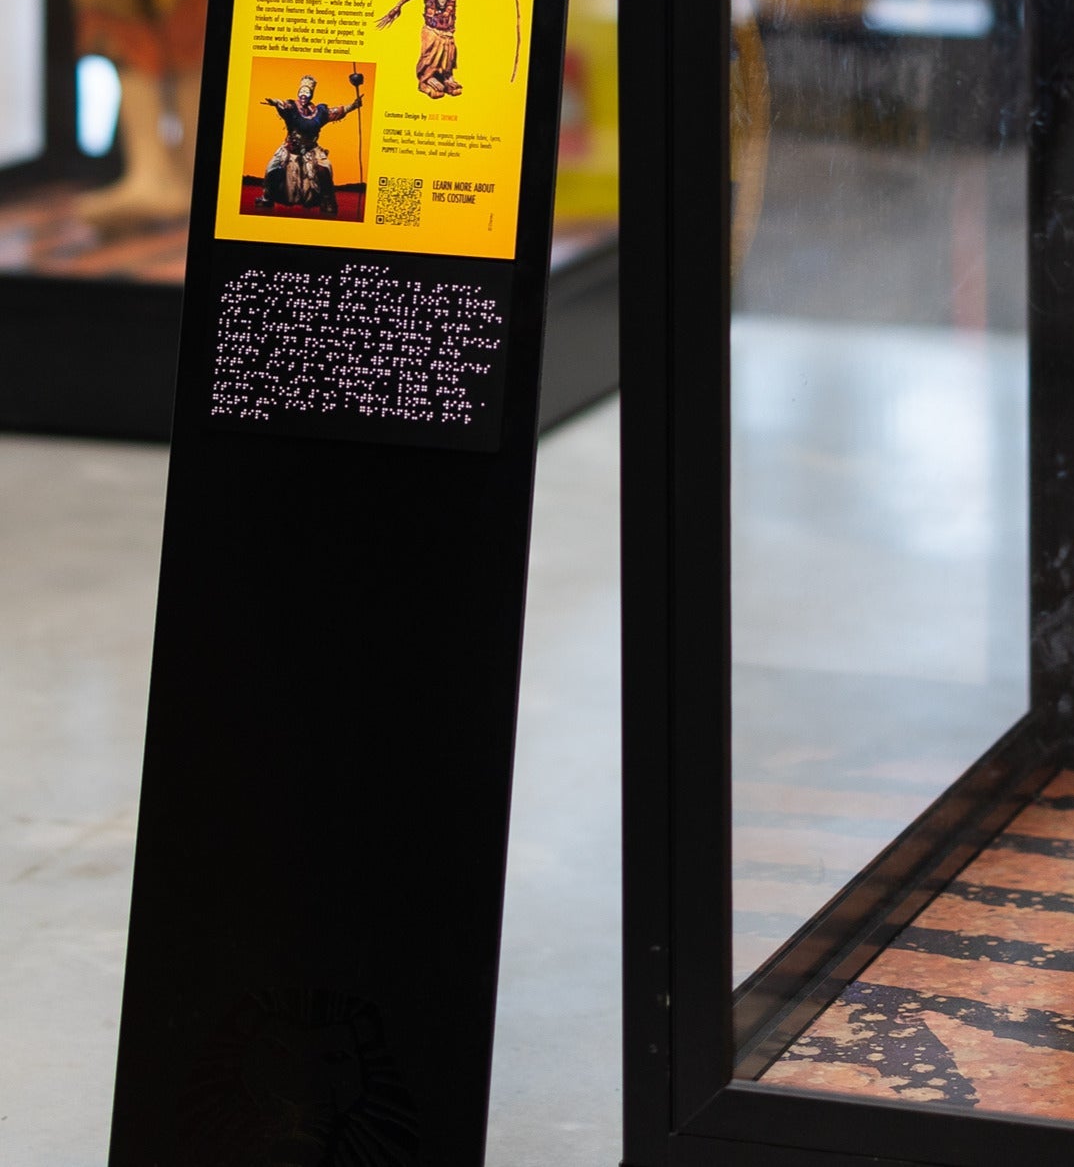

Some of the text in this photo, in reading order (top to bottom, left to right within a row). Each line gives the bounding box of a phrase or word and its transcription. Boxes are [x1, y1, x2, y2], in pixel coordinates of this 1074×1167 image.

[432, 180, 495, 193] LEARN MORE ABOUT
[432, 192, 476, 204] THIS COSTUME
